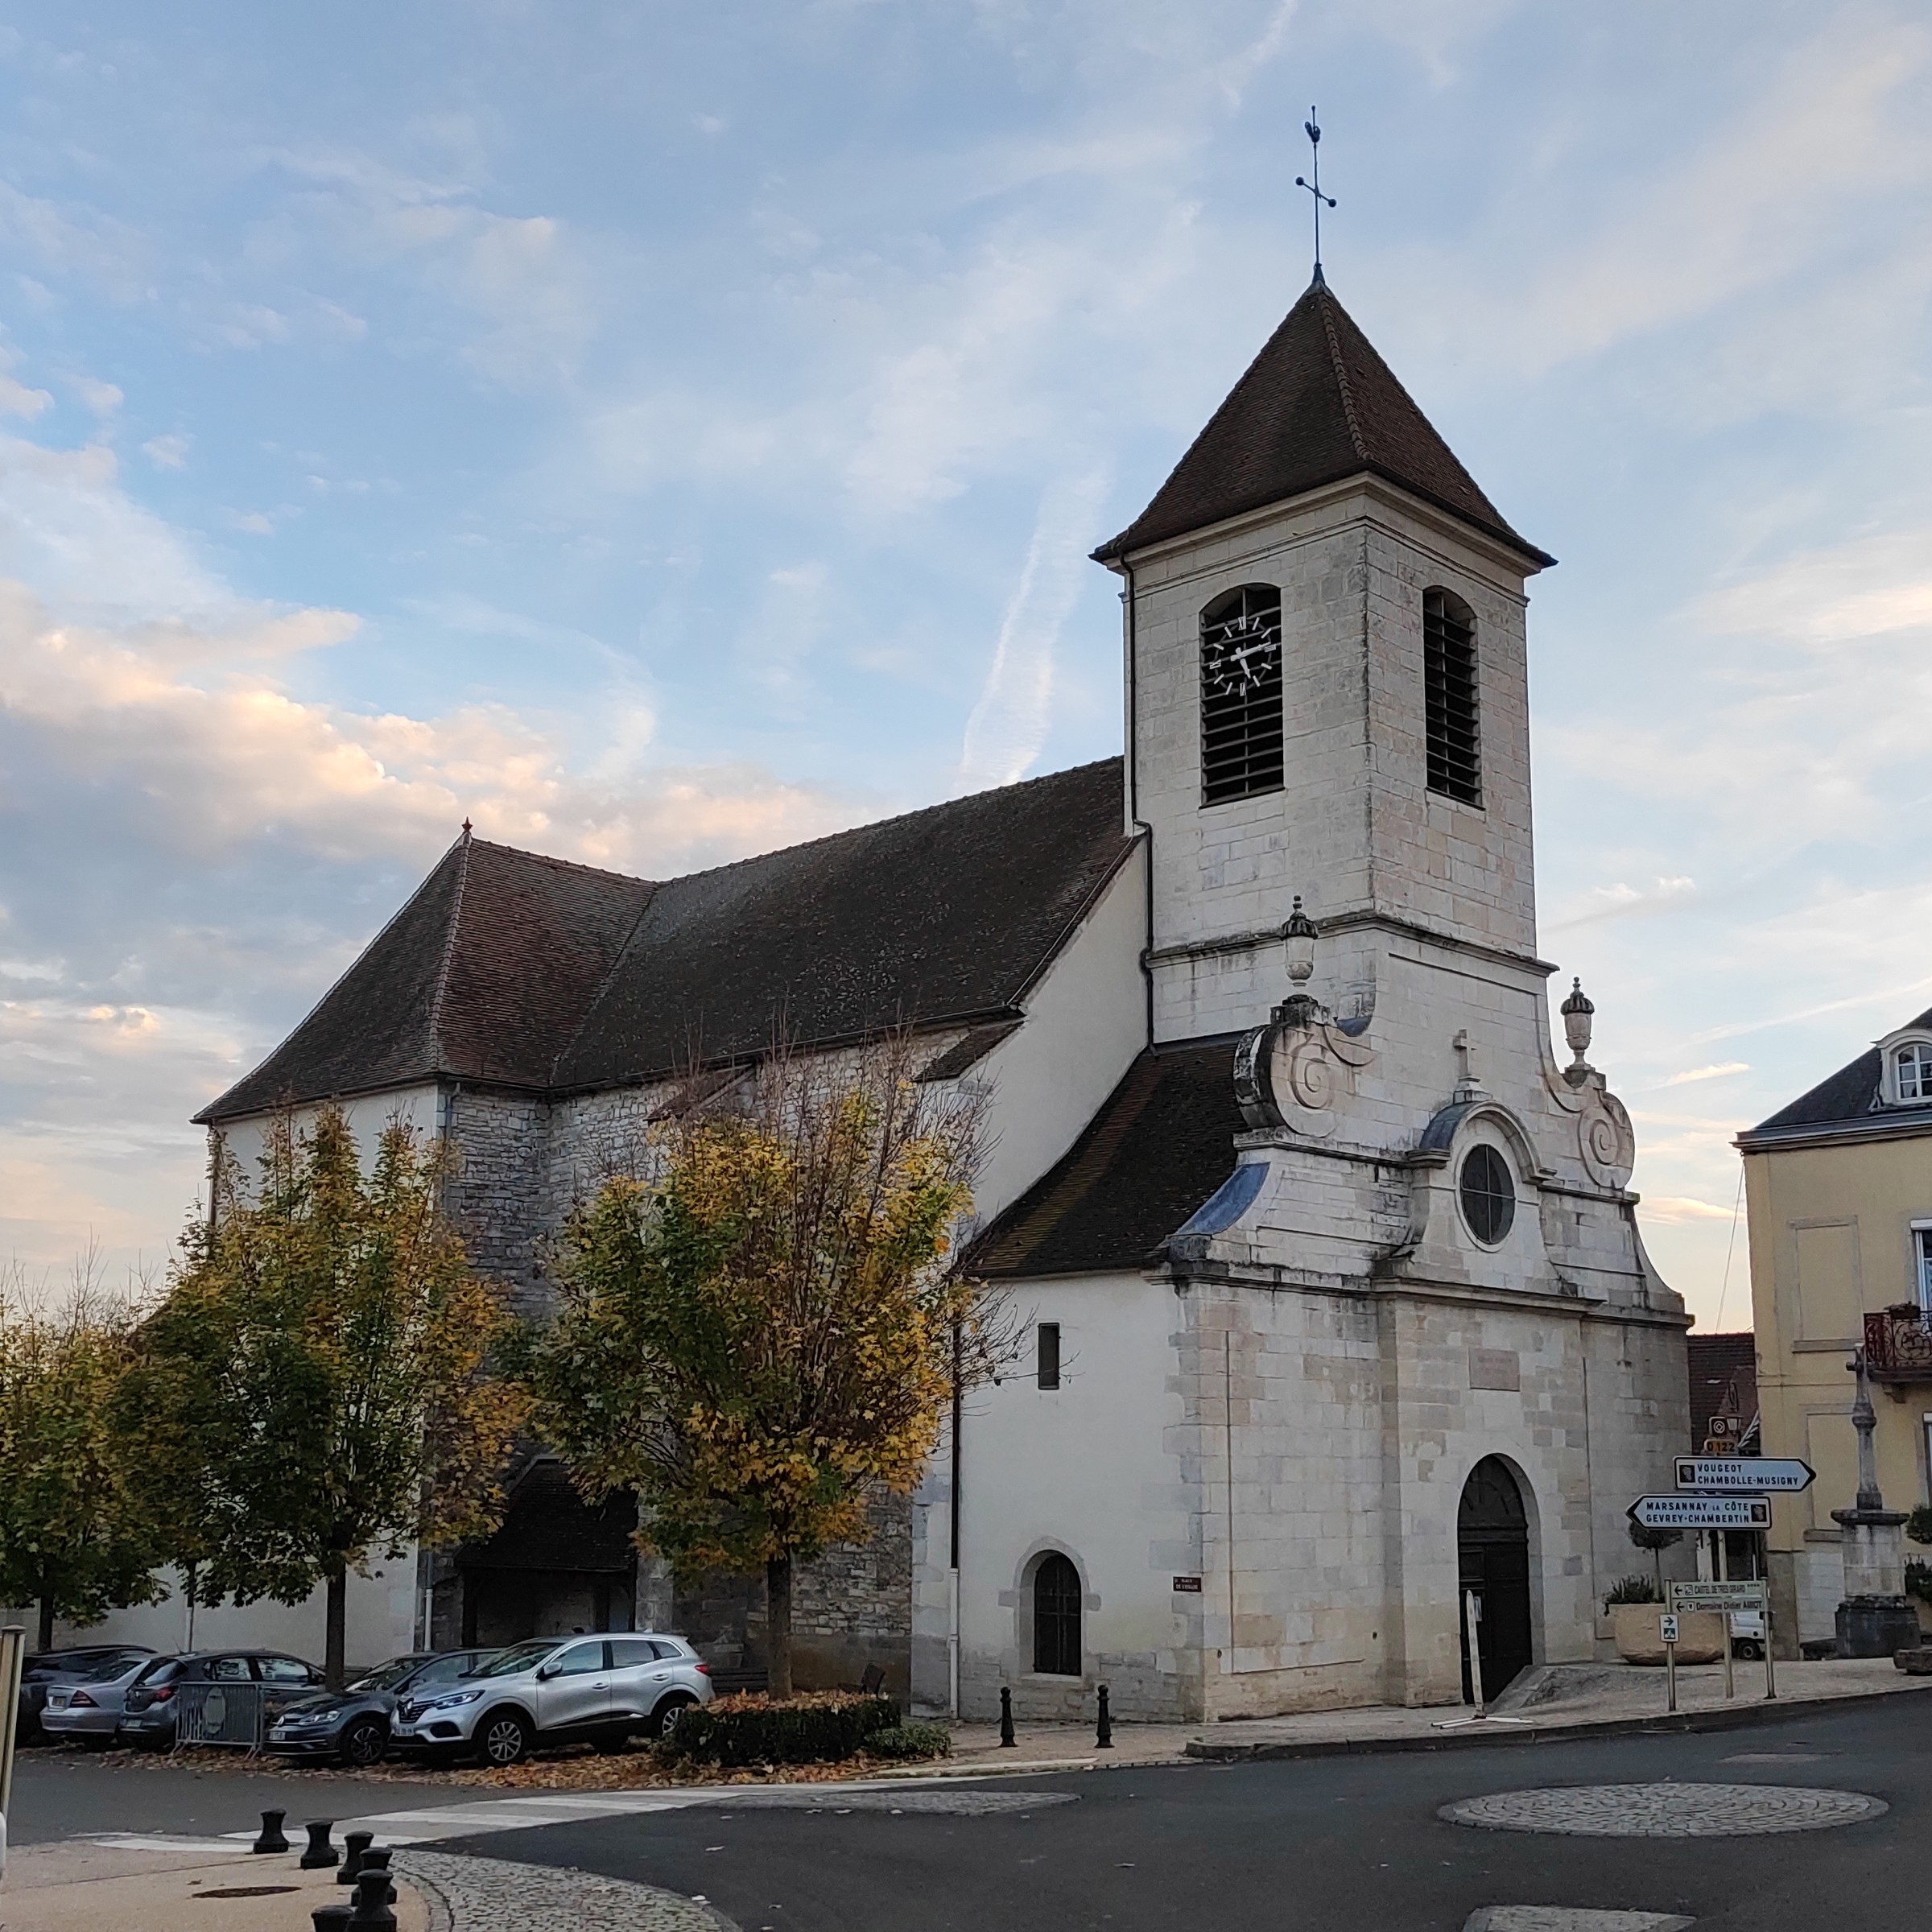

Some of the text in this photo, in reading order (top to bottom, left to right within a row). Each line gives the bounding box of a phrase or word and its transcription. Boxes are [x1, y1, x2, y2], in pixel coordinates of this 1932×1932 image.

[1716, 1442, 1736, 1452] 122
[1698, 1464, 1742, 1473] VOUGEOT
[1698, 1476, 1798, 1485] CHAMBOLLE-MUSIGNY
[1646, 1502, 1707, 1511] MARSANNAY
[1724, 1501, 1748, 1511] CÔTE
[1646, 1514, 1749, 1523] GEVREY-CHAMBERTIN
